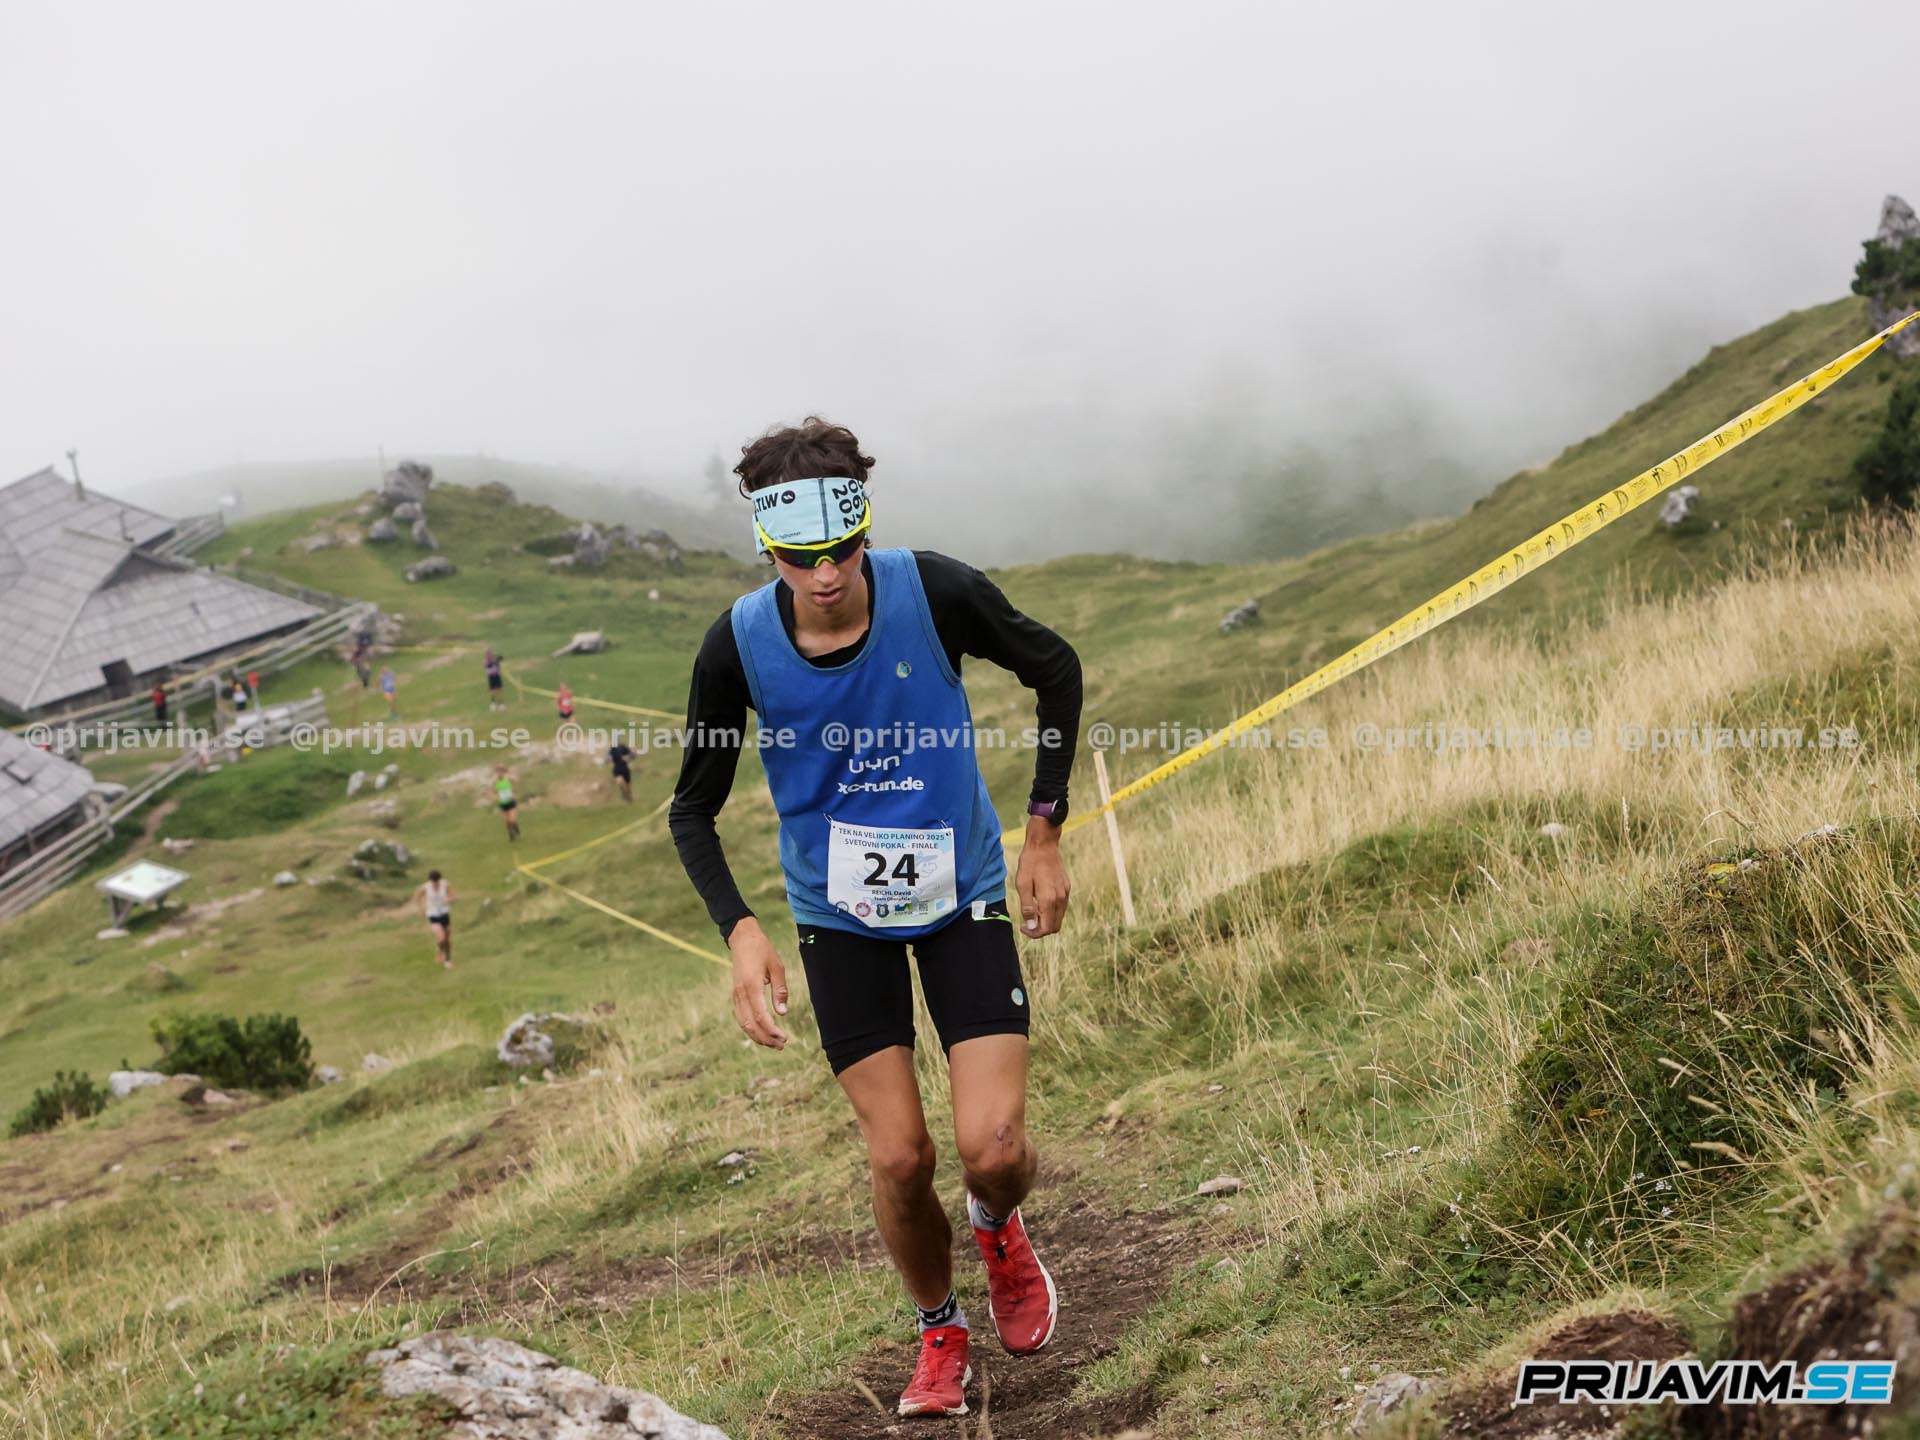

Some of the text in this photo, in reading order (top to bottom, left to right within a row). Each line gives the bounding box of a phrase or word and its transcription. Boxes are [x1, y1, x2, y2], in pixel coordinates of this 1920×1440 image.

[838, 777, 925, 794] xc-run.de
[839, 828, 853, 836] TEK
[853, 830, 864, 838] NA
[864, 831, 889, 840] VELIKO
[891, 833, 925, 841] PLANINO
[844, 838, 880, 849] SVETOVNI
[863, 852, 920, 887] 24
